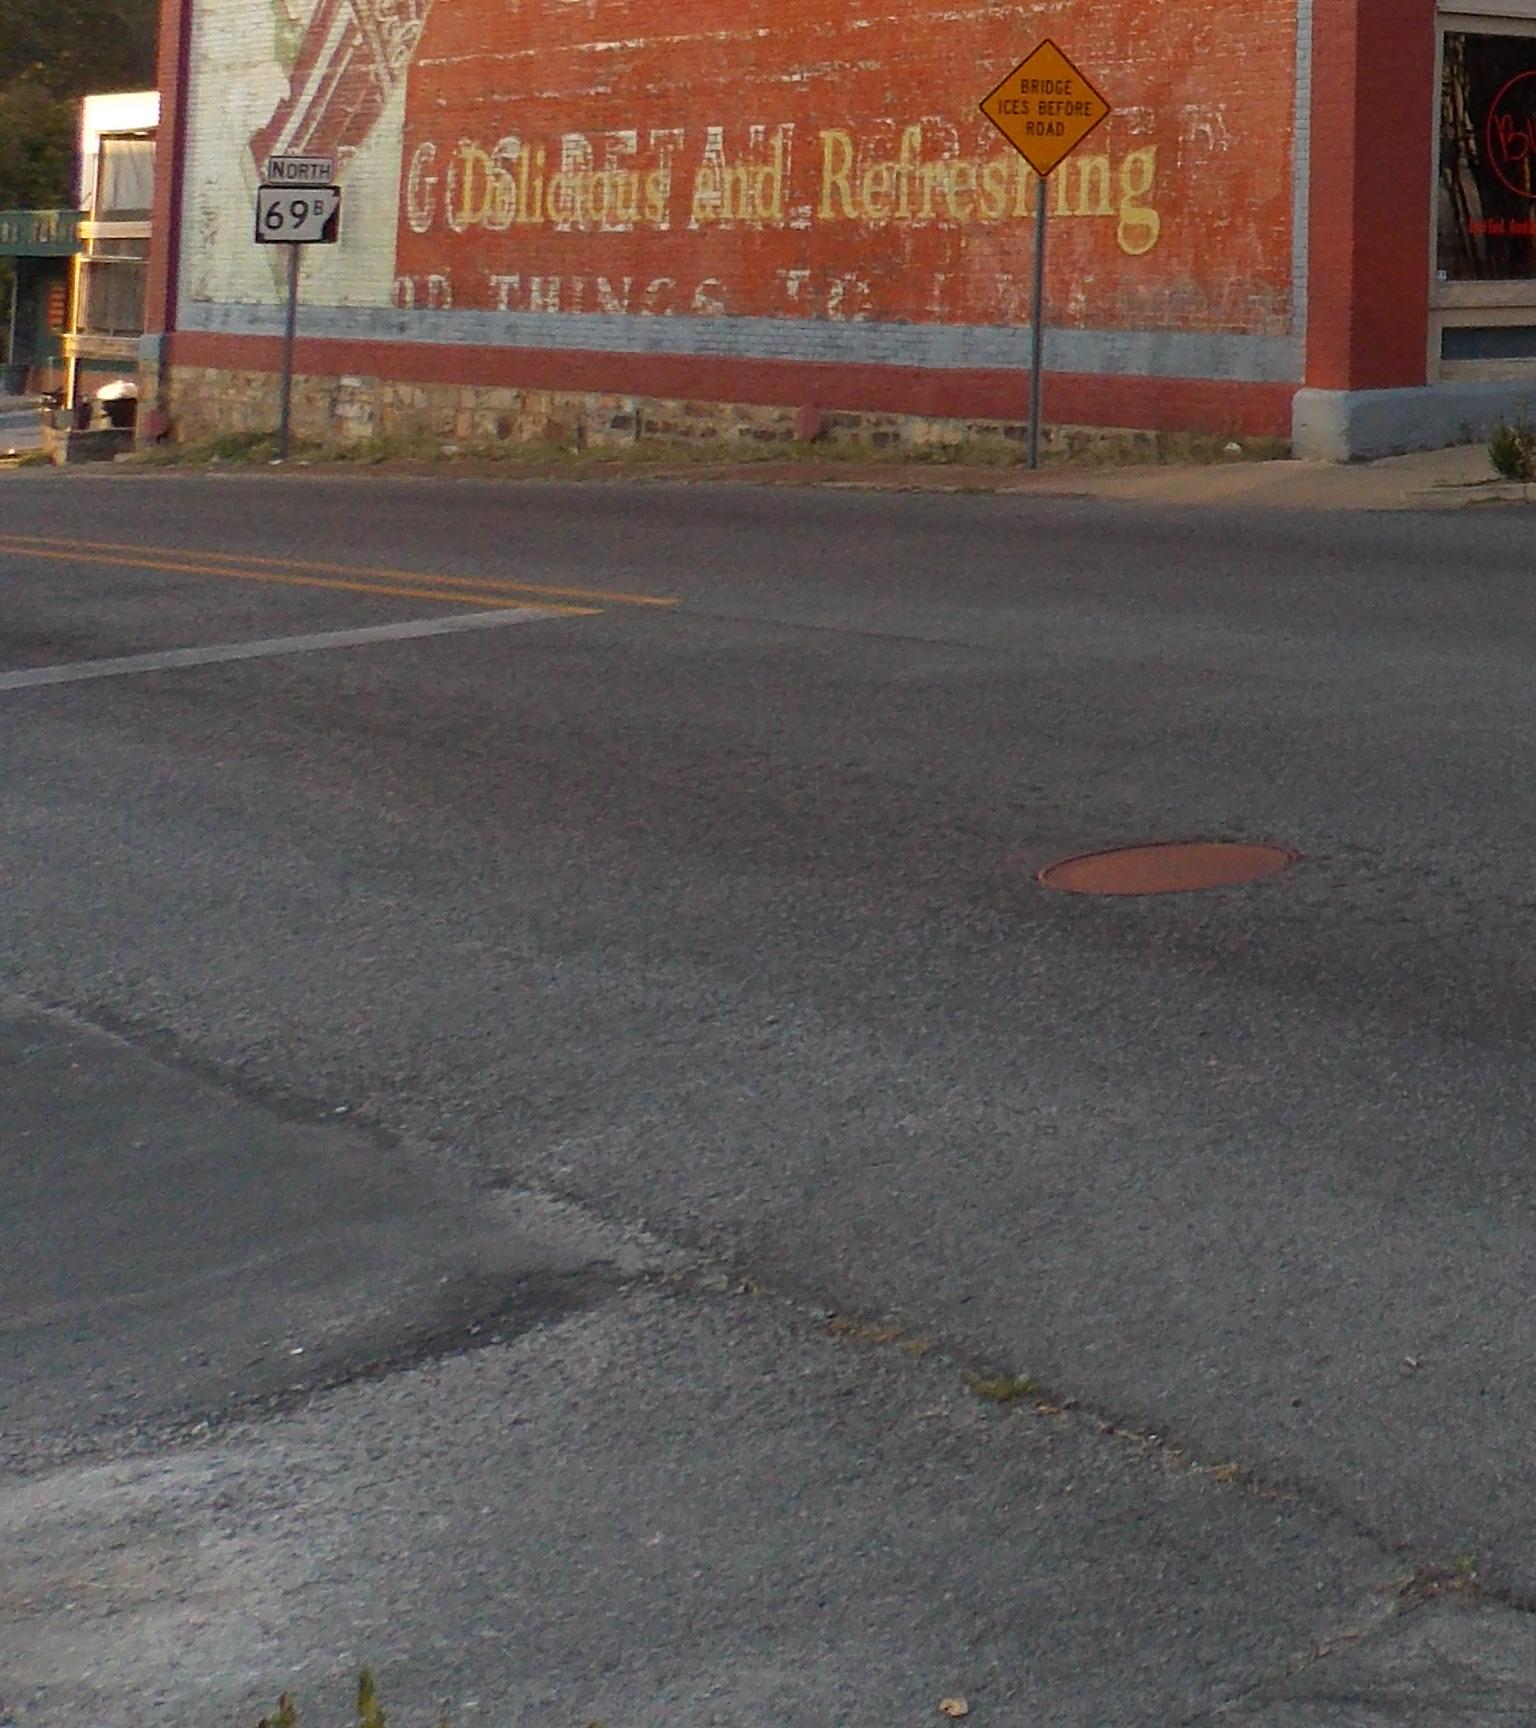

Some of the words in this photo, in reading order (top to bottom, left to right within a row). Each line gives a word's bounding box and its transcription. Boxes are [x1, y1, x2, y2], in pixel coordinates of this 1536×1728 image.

[1020, 78, 1072, 95] BRIDGE
[998, 98, 1029, 115] ICES
[1037, 100, 1093, 117] BEFORE
[1025, 121, 1065, 137] ROAD
[272, 160, 331, 180] NORTH
[456, 142, 667, 224] Delicious
